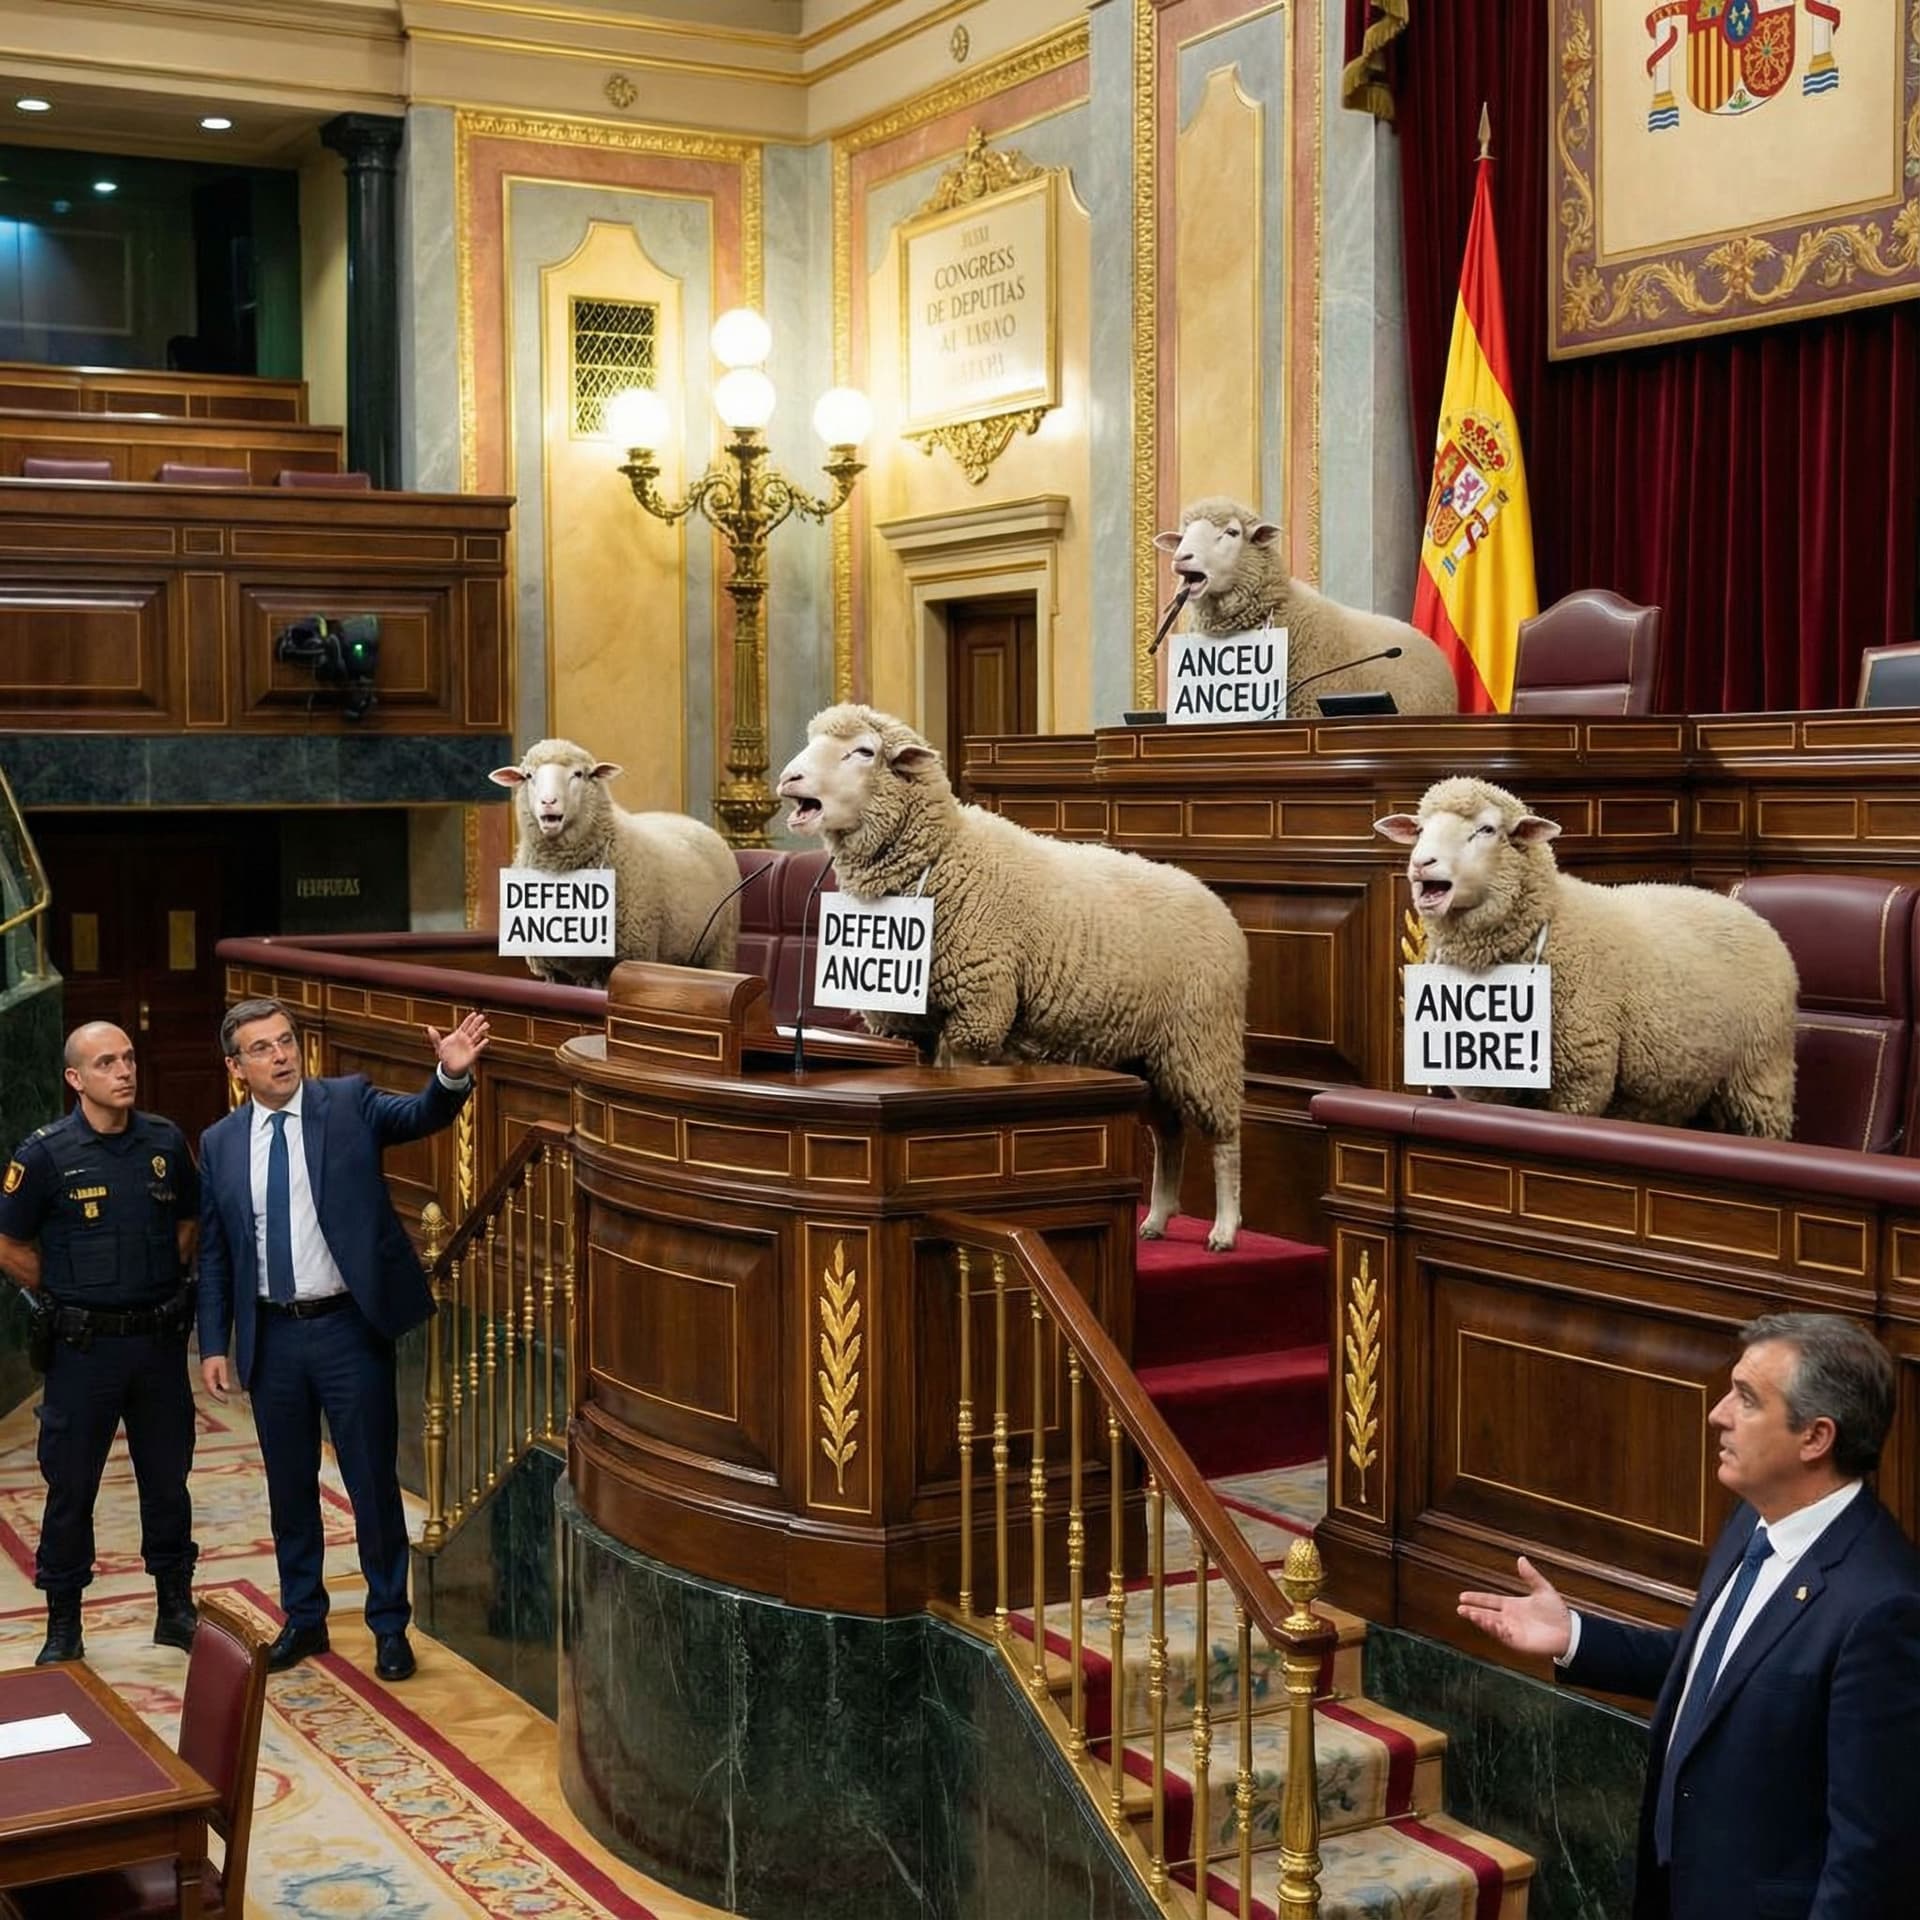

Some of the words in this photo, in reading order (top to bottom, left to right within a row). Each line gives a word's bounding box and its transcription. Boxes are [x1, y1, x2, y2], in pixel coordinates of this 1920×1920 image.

[935, 246, 1015, 290] CONGRESS
[928, 301, 944, 325] DE
[1177, 645, 1274, 678] ANCEU
[1174, 680, 1280, 714] ANCEU!
[506, 882, 609, 910] DEFEND
[507, 916, 607, 944] ANCEU!
[824, 913, 926, 951] DEFEND
[822, 955, 922, 997] ANCEU!
[1415, 984, 1534, 1022] ANCEU
[1423, 1031, 1538, 1073] LIBRE!
